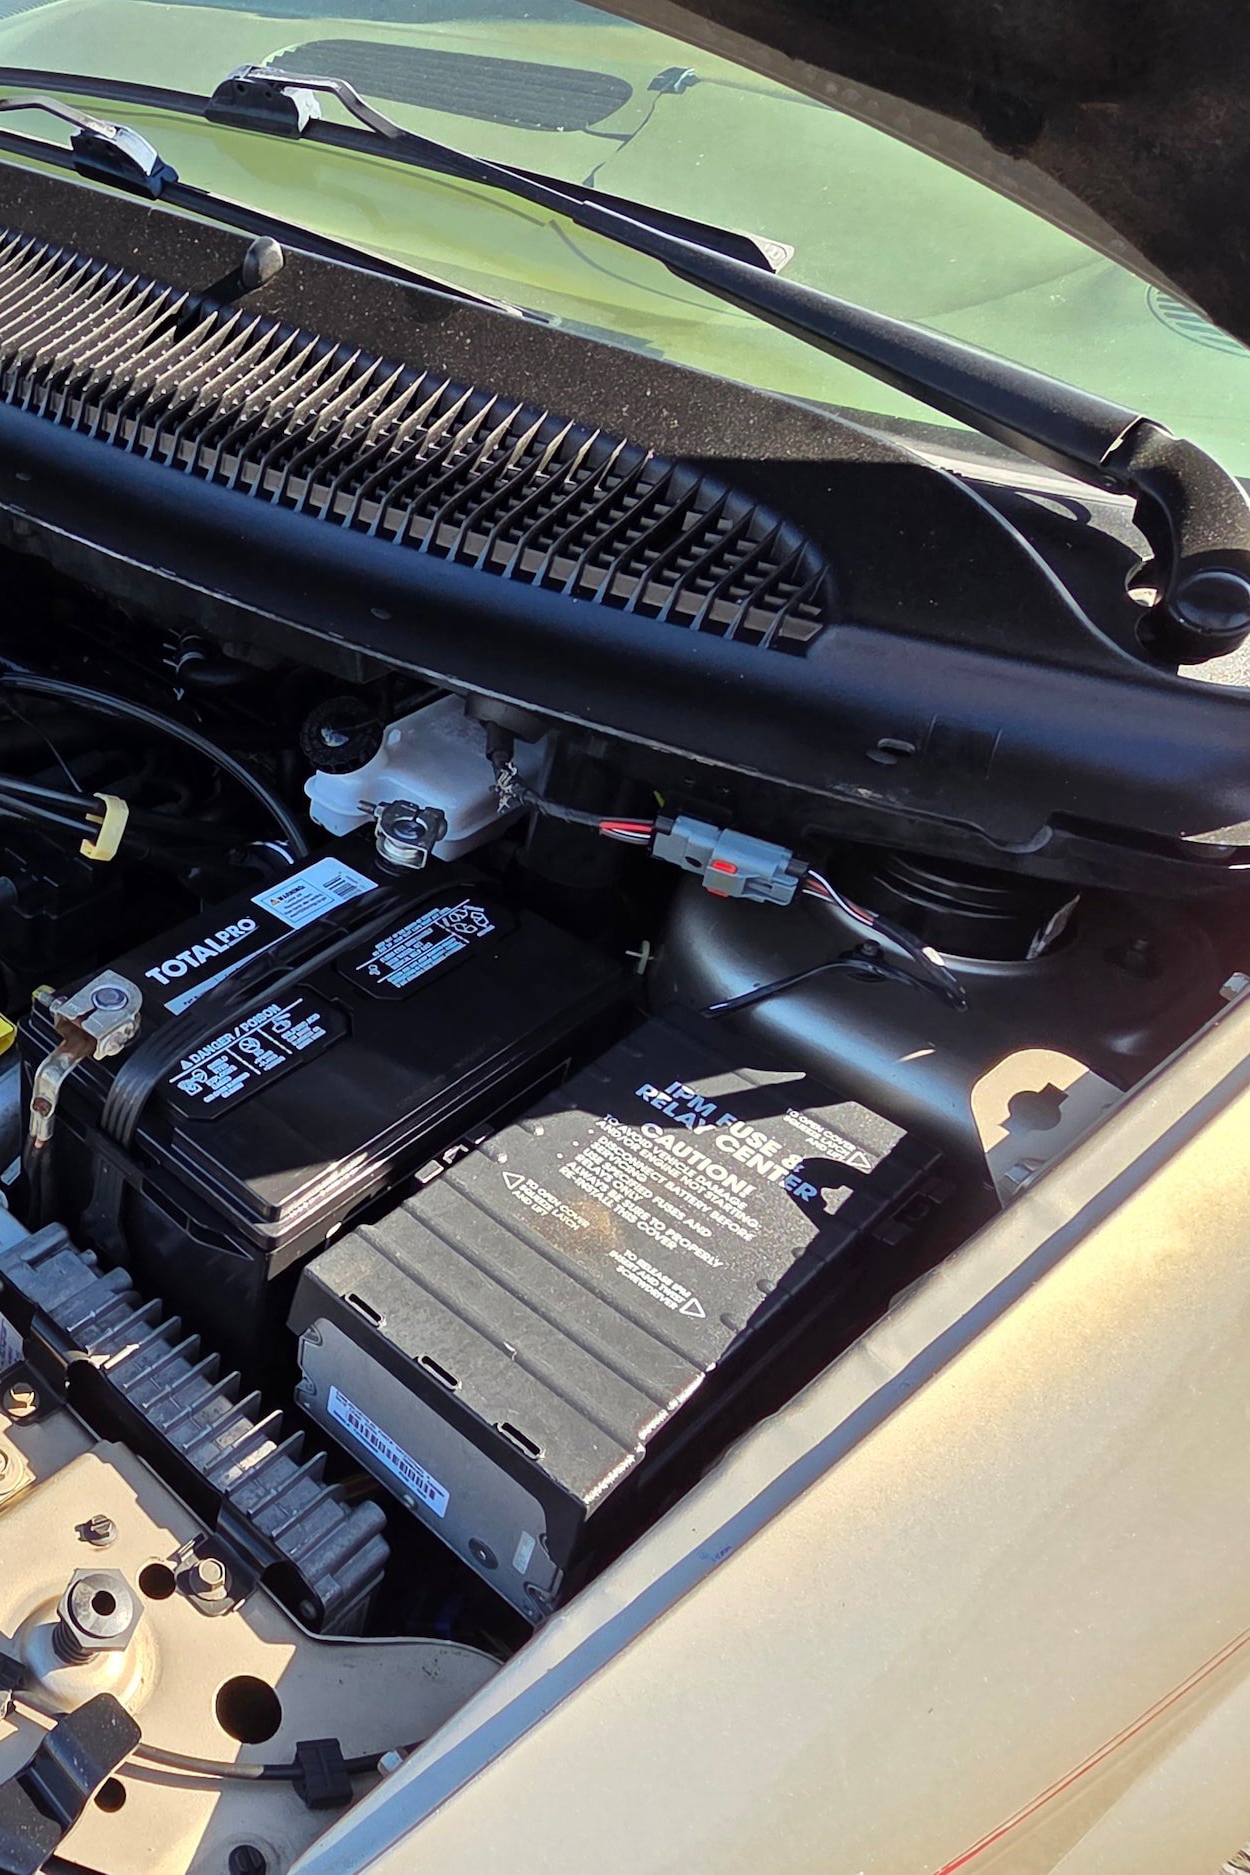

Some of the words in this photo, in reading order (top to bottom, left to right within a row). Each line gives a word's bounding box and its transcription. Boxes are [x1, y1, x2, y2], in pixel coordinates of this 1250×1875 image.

[143, 915, 254, 985] TOTALPRO
[633, 1082, 717, 1138] RELAY
[709, 1131, 821, 1202] CENTER
[663, 1080, 719, 1117] IPM
[713, 1112, 784, 1157] FUSE
[778, 1151, 811, 1173] &
[781, 1114, 822, 1139] SQUEEZE
[818, 1136, 851, 1157] LATCH
[784, 1107, 800, 1118] TO
[797, 1115, 825, 1132] OPEN
[821, 1129, 857, 1152] COVER
[804, 1136, 828, 1151] AND
[825, 1148, 845, 1161] LIFT
[572, 1153, 614, 1182] RELAYS
[609, 1179, 644, 1202] ONLY
[589, 1141, 649, 1183] SERVICING
[594, 1119, 642, 1151] AND/OR
[637, 1148, 682, 1178] ENGINE
[678, 1175, 706, 1194] NOT
[702, 1190, 763, 1231] STARTING:
[601, 1113, 621, 1126] TO
[615, 1123, 654, 1149] AVOID
[649, 1145, 697, 1177] VEHICLE
[693, 1174, 749, 1210] DAMAGE
[636, 1120, 757, 1198] CAUTION!
[510, 1189, 534, 1205] AND
[528, 1203, 549, 1217] LIFT
[517, 1183, 555, 1211] SQUEEZE
[550, 1209, 581, 1230] LATCH
[524, 1178, 540, 1190] TO
[535, 1187, 562, 1206] OPEN
[557, 1203, 591, 1228] COVER
[557, 1166, 617, 1208] RE-INSTALL
[611, 1204, 639, 1223] THIS
[634, 1219, 679, 1250] COVER
[565, 1160, 611, 1192] ALWAYS
[606, 1189, 624, 1202] BE
[619, 1199, 651, 1221] SURE
[646, 1216, 668, 1231] TO
[663, 1228, 724, 1269] PROPERLY
[580, 1147, 605, 1164] USE
[600, 1161, 655, 1199] SPECIFIED
[650, 1195, 687, 1220] FUSES
[681, 1216, 714, 1238] AND
[596, 1135, 668, 1184] DISCONNECT
[663, 1180, 712, 1213] BATTERY
[707, 1210, 755, 1241] BEFORE
[607, 1249, 641, 1272] INSERT
[635, 1269, 661, 1287] AND
[656, 1282, 687, 1304] TWIST
[614, 1264, 679, 1310] SCREWDRIVER
[621, 1249, 640, 1262] TO
[634, 1258, 674, 1286] RELEASE
[670, 1282, 693, 1298] IPM
